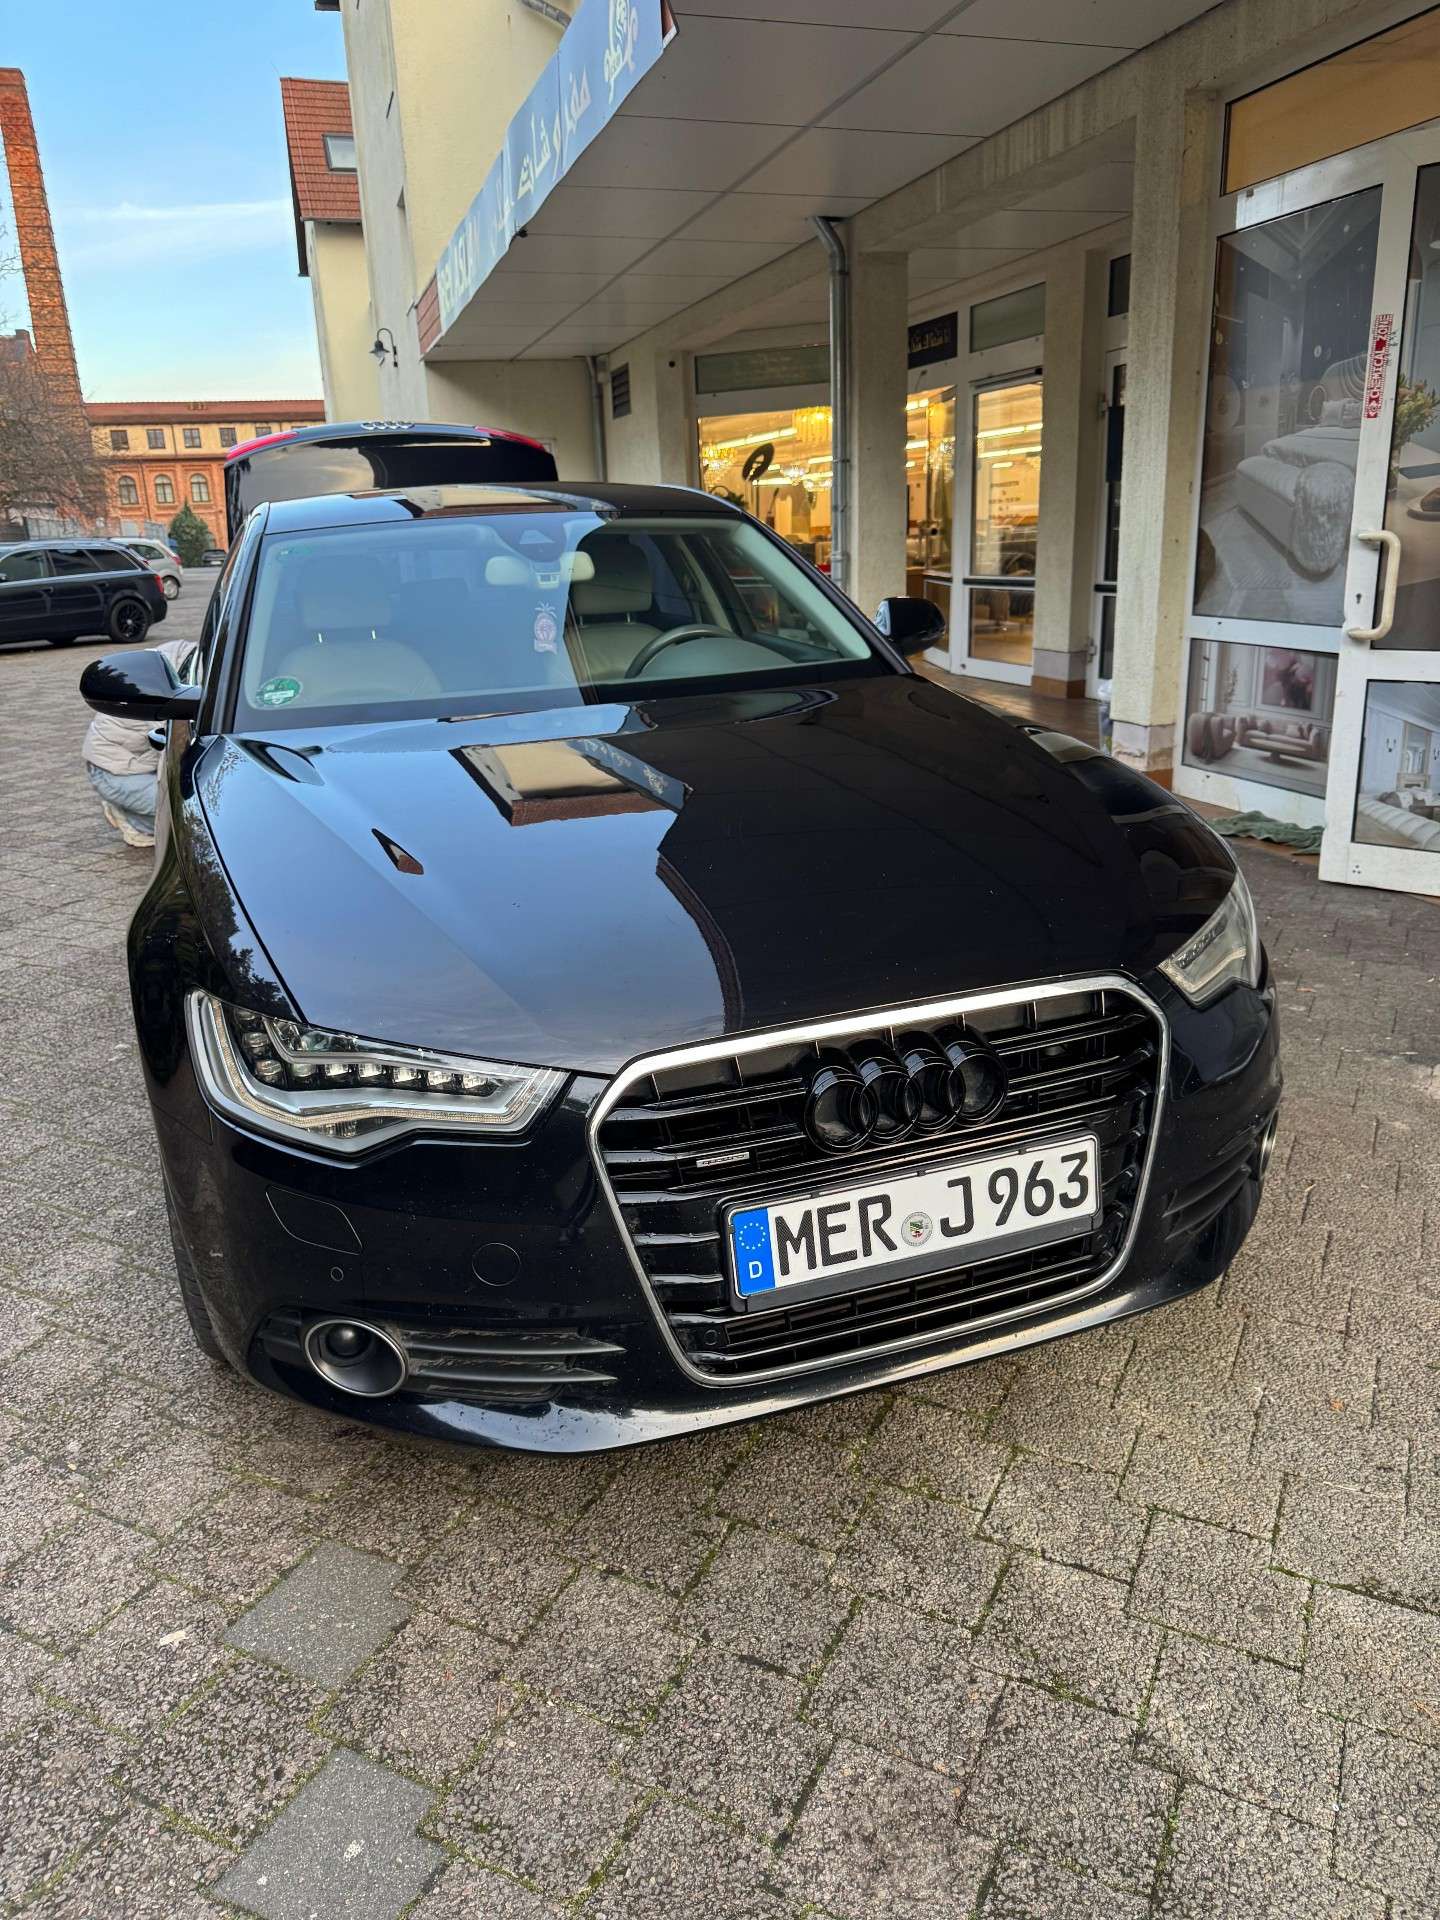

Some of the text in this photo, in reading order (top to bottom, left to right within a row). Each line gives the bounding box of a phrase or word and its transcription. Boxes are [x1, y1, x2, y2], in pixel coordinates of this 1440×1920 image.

[775, 1193, 898, 1277] MER
[940, 1176, 975, 1238] J
[987, 1150, 1090, 1227] 963
[749, 1260, 763, 1280] D
